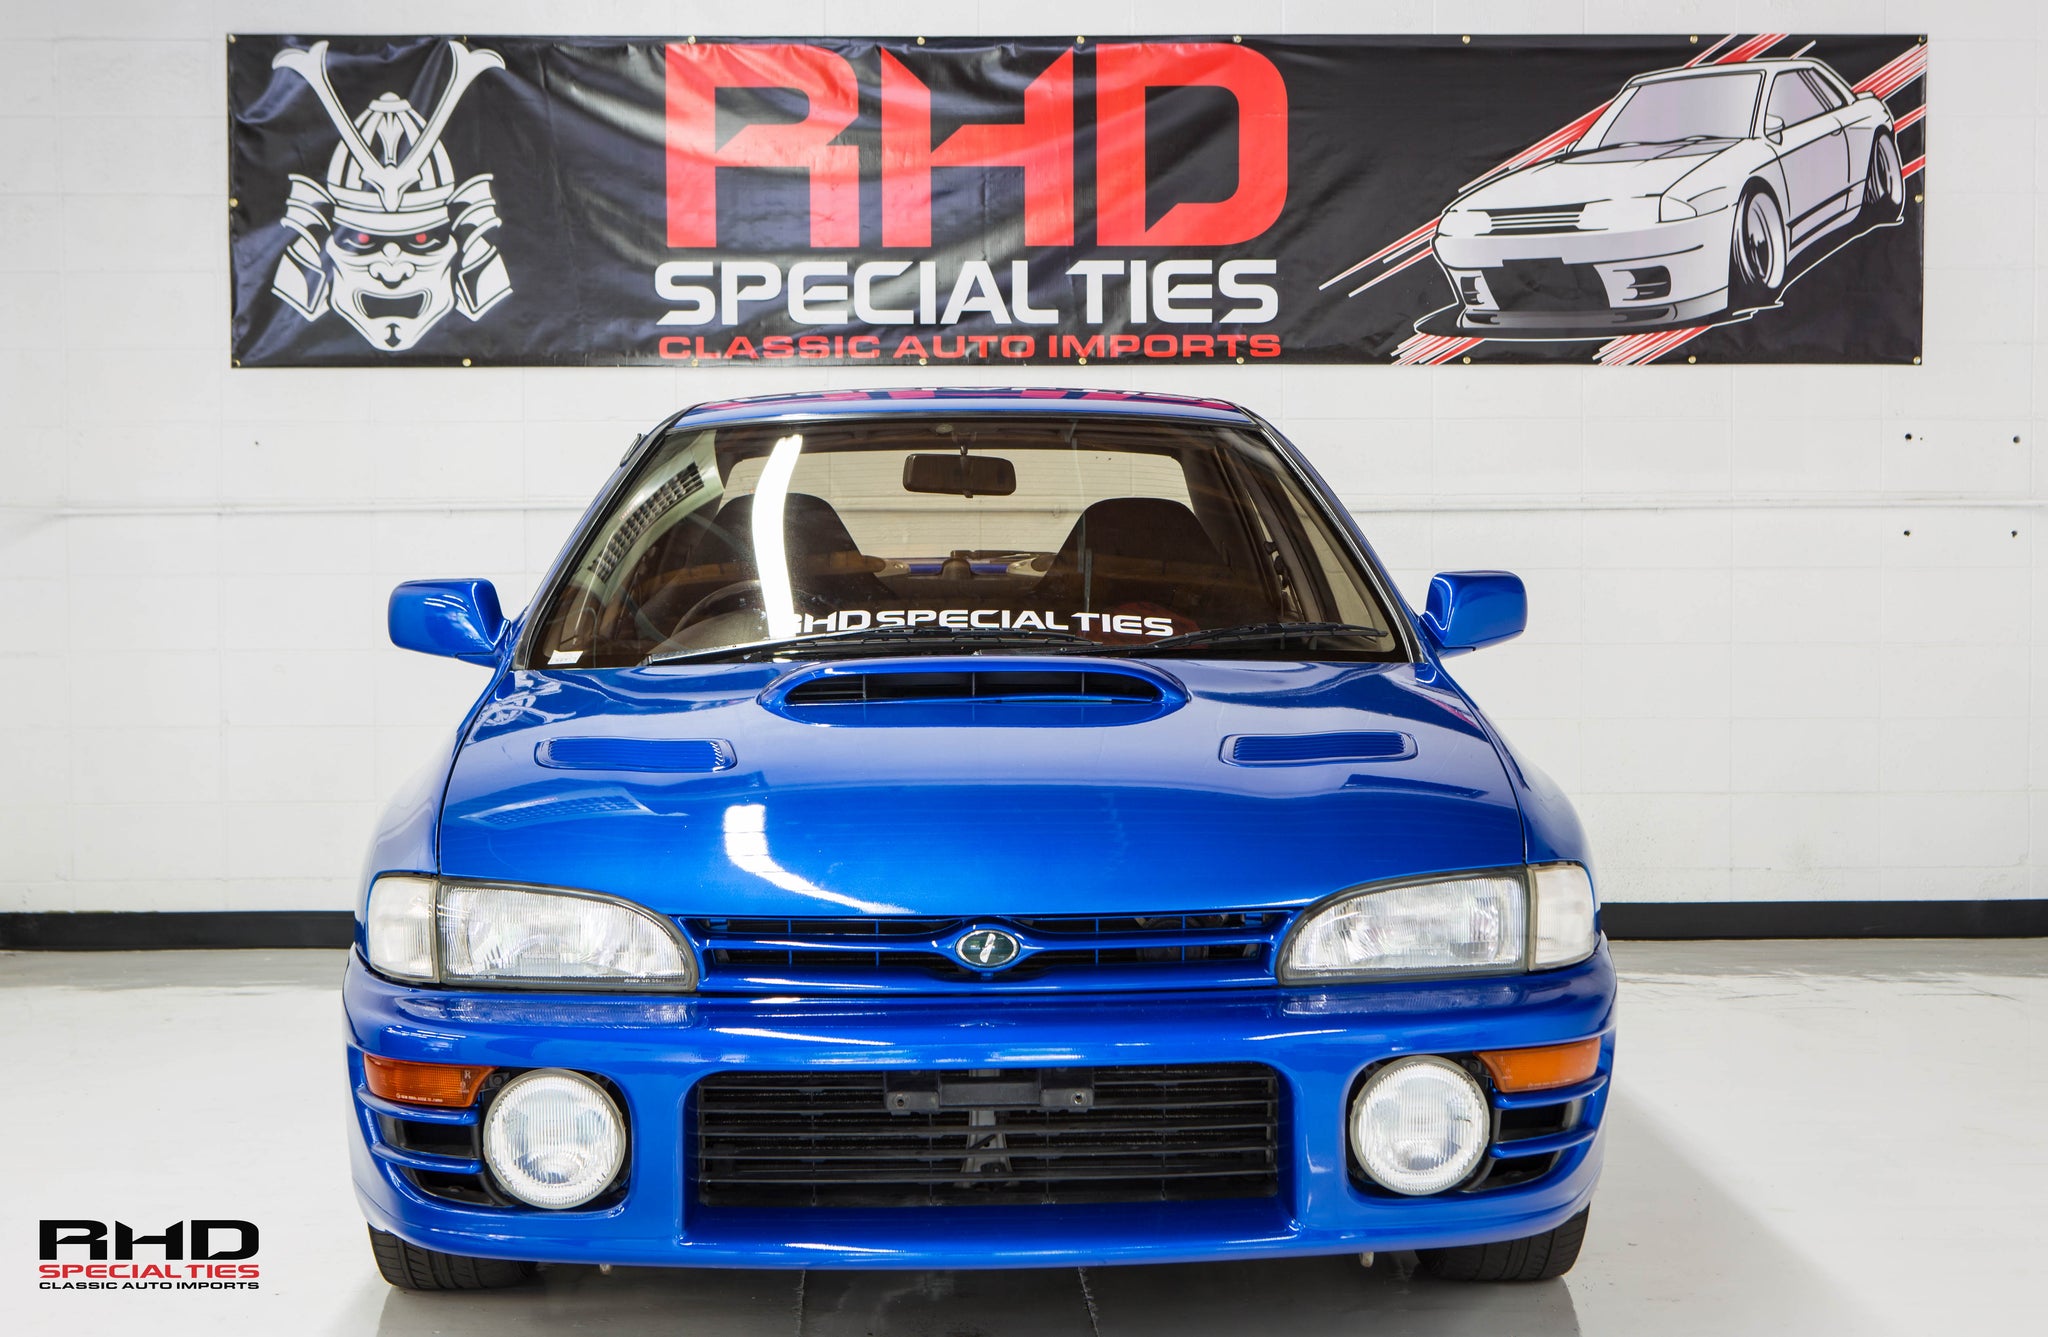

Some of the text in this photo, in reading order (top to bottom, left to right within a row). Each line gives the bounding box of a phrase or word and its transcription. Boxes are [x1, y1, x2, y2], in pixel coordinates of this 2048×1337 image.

[665, 43, 1288, 247] RHD
[654, 259, 1279, 325] SPECIALTIES
[658, 334, 1281, 359] CLASSIC AUTO IMPORTS
[876, 609, 1174, 637] SPECIALTIES
